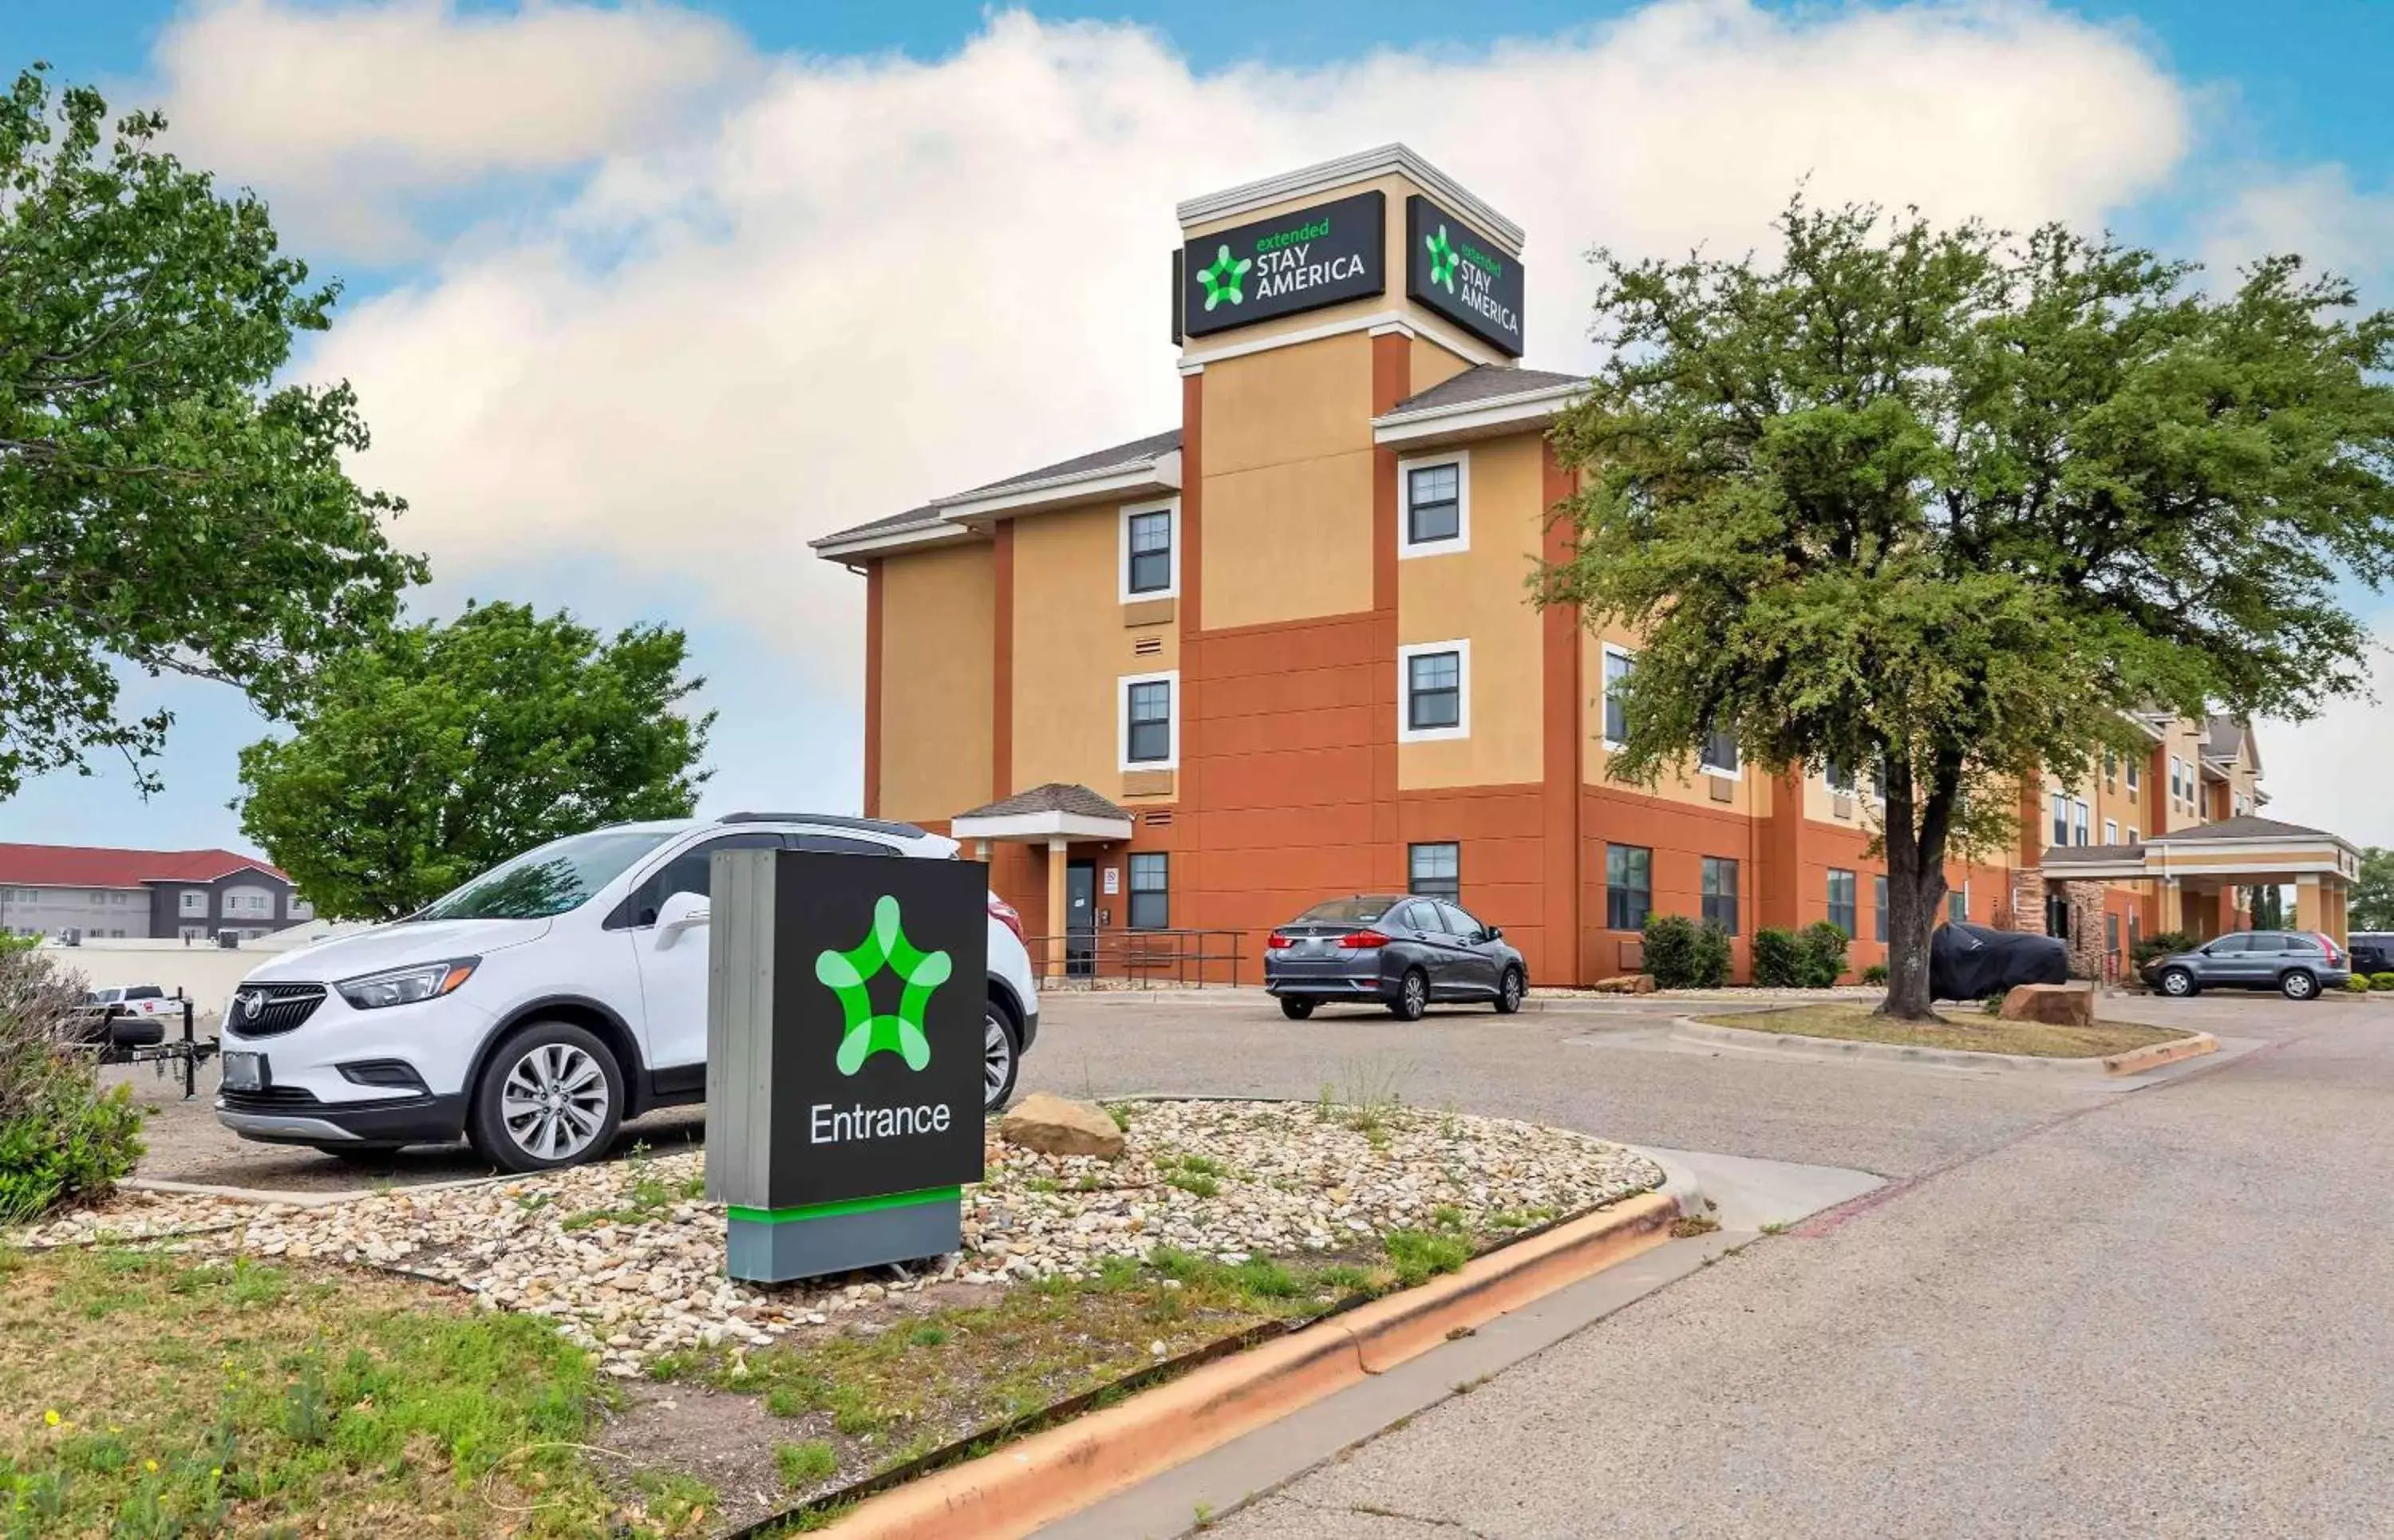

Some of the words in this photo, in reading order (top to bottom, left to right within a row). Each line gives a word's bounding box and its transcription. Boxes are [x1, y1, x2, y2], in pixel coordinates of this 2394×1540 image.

[1256, 217, 1329, 252] extended
[1255, 254, 1365, 301] AMERICA
[1256, 243, 1311, 278] STAY
[1461, 243, 1501, 278] extended
[1461, 259, 1491, 294] STAY
[1461, 283, 1519, 336] AMERICA
[810, 1103, 951, 1144] Entrance
